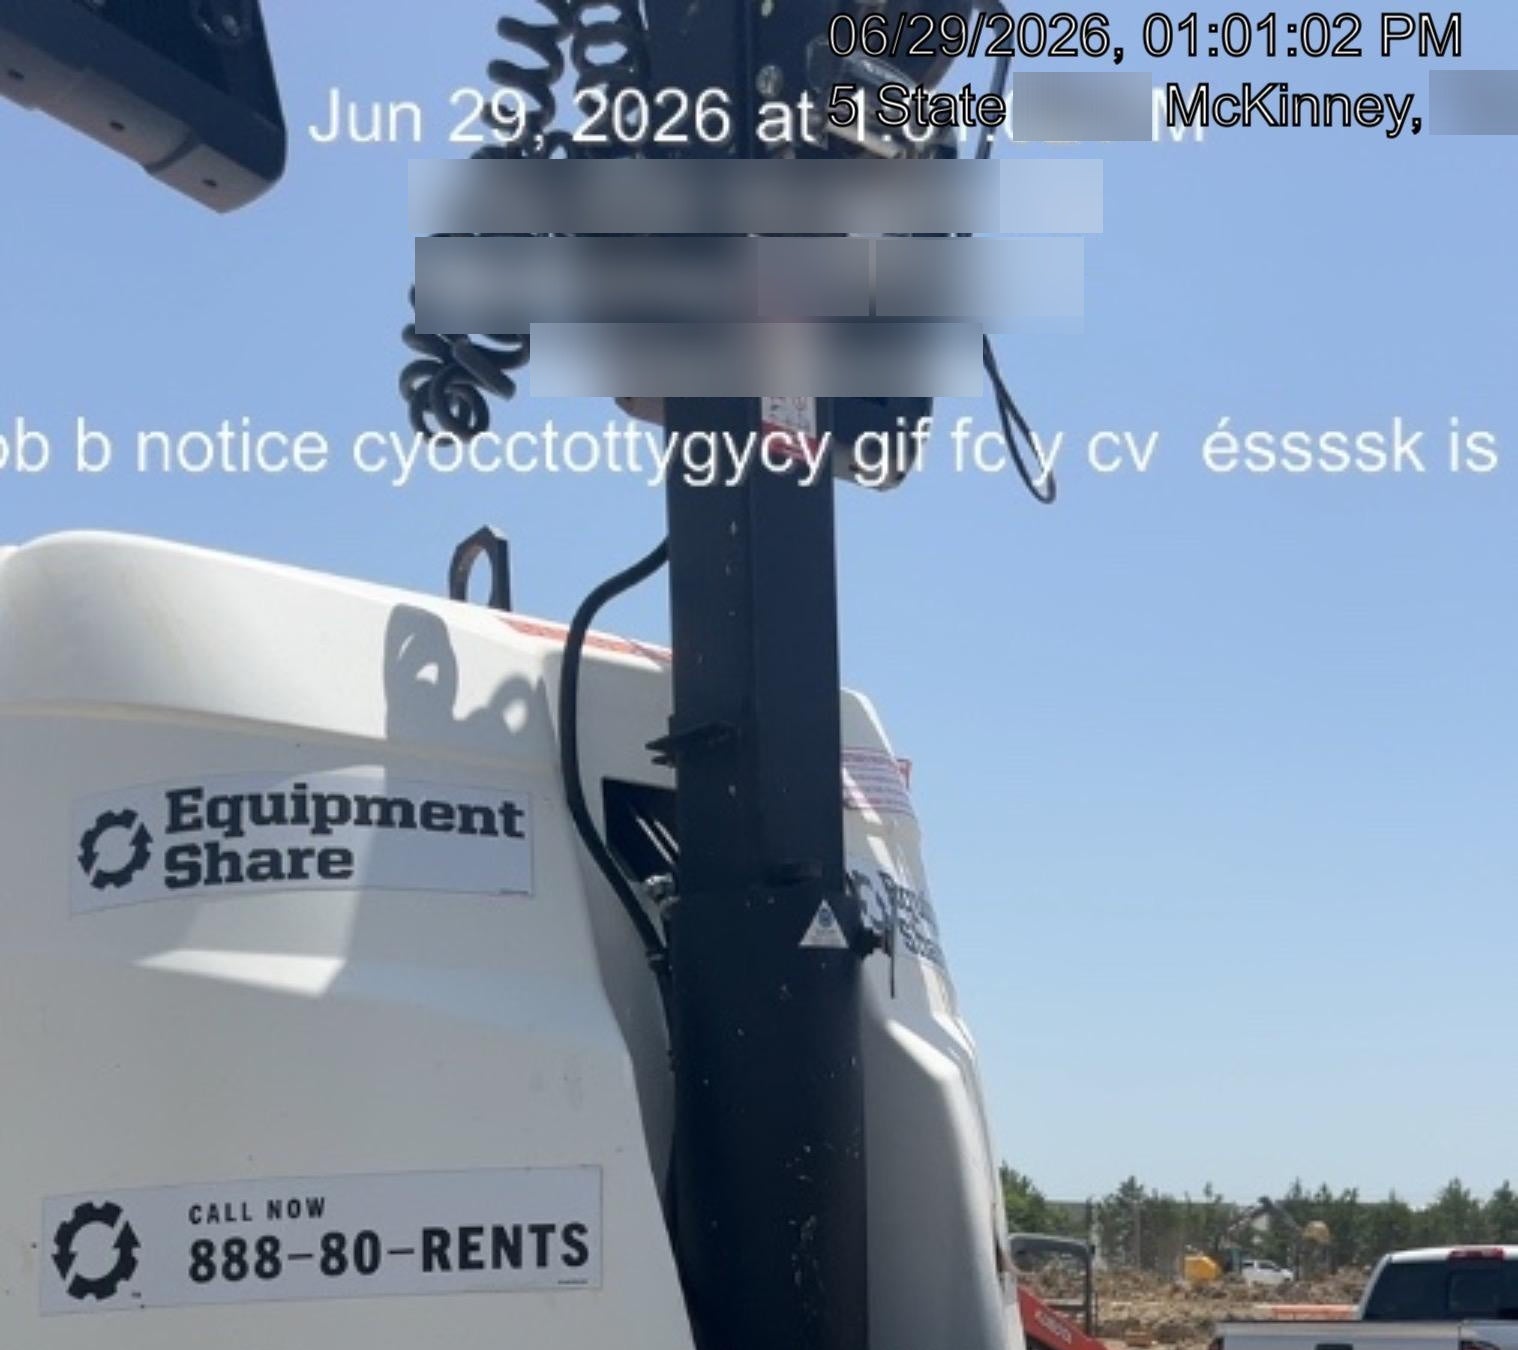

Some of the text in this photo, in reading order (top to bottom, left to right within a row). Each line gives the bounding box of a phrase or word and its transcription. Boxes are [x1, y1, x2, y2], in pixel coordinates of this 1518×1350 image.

[164, 782, 525, 839] Equipment
[163, 840, 354, 890] Share
[187, 1196, 327, 1225] CALL NOW
[187, 1222, 590, 1284] 888-80-RENTS
